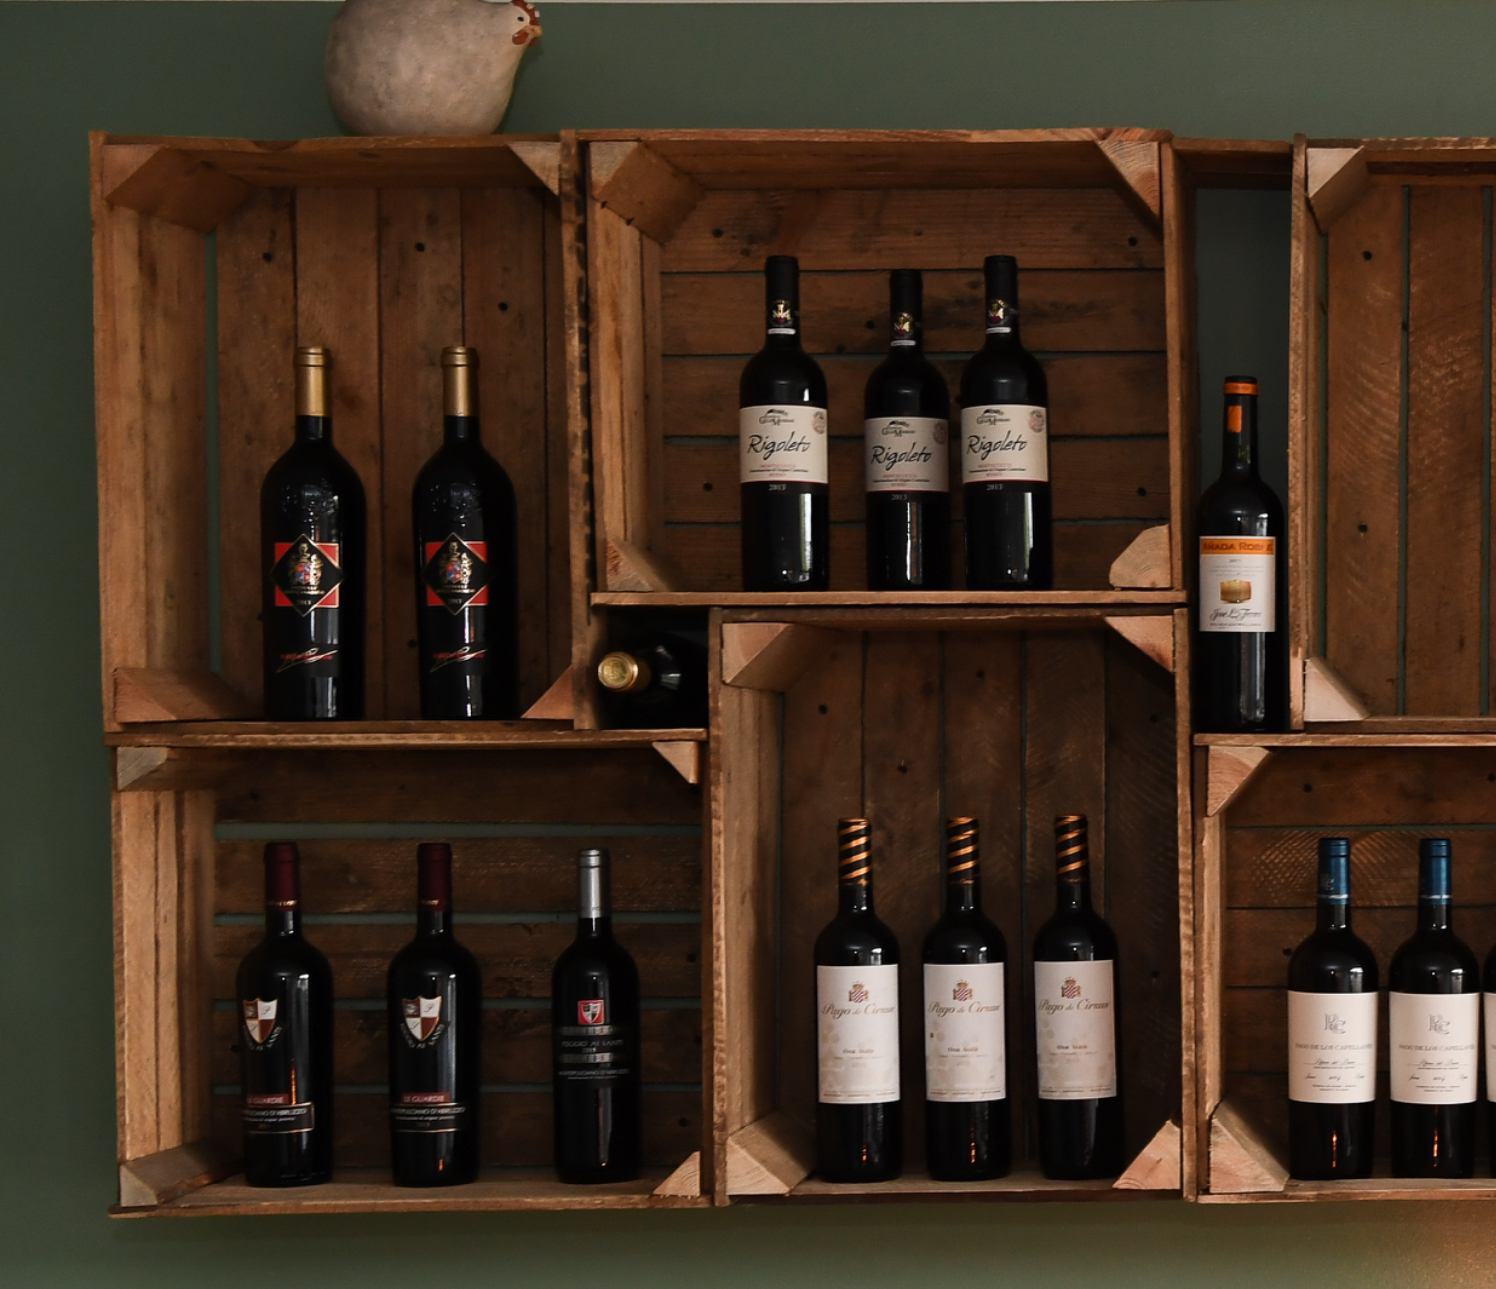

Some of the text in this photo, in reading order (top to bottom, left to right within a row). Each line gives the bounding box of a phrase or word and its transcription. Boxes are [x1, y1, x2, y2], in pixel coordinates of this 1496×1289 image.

[747, 431, 811, 461] Rigoleto
[871, 442, 932, 471] Rigoleto
[966, 430, 1027, 461] Rigoleto
